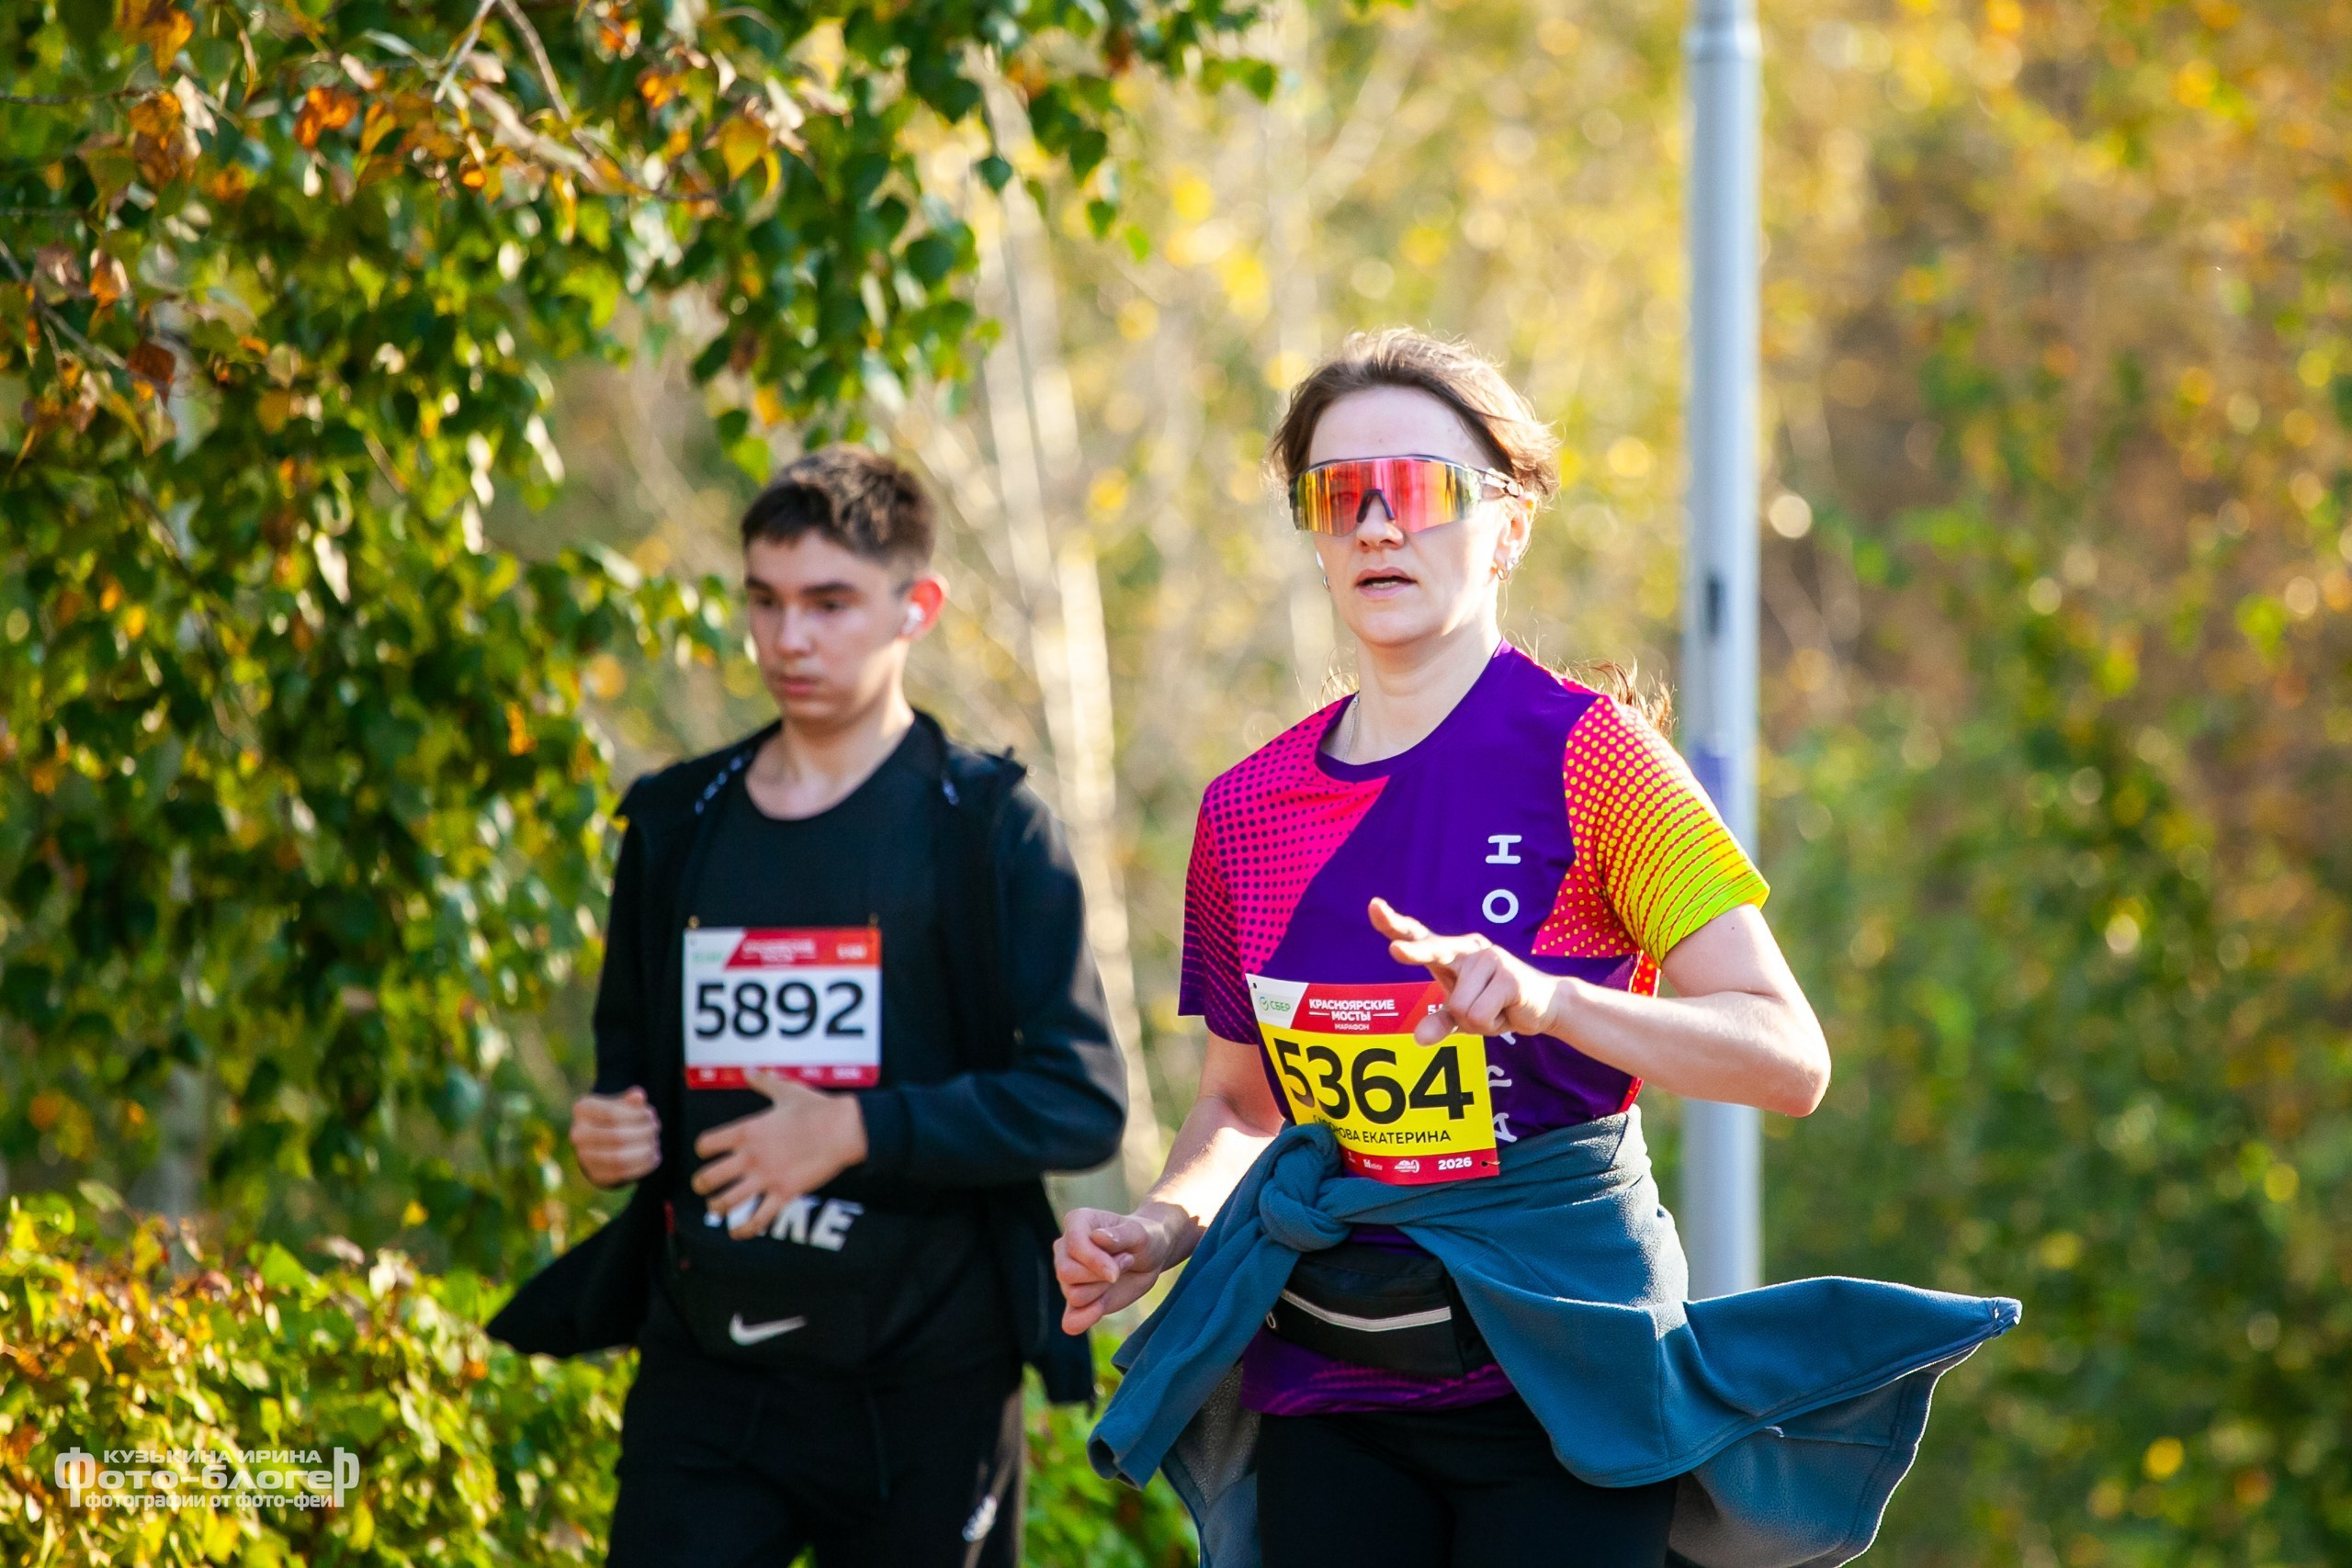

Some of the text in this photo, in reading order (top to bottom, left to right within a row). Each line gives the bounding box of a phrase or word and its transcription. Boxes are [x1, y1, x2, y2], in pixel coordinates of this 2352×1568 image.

[695, 981, 865, 1038] 5892
[1270, 1000, 1291, 1012] СБЕР
[1308, 998, 1396, 1010] КРАСНОЯРСКИЕ
[1332, 1011, 1371, 1021] МОСТЫ
[1273, 1038, 1475, 1125] 5364
[1363, 1130, 1452, 1145] ЕКАТЕРИНА
[1438, 1156, 1472, 1170] 2026
